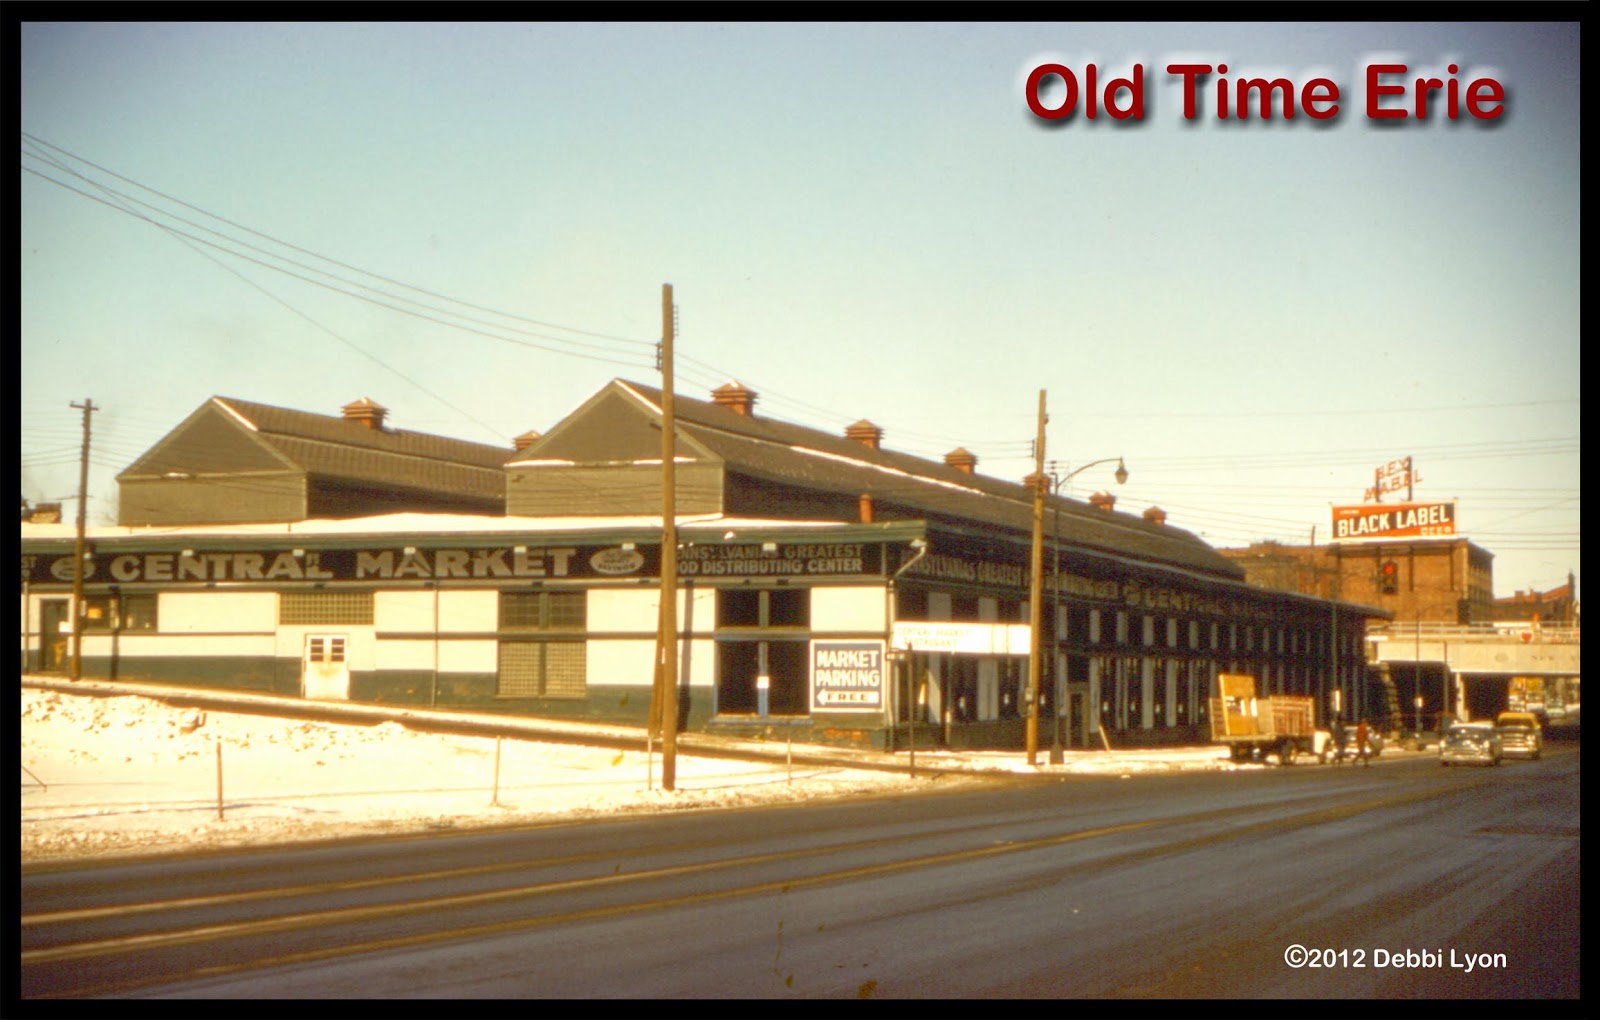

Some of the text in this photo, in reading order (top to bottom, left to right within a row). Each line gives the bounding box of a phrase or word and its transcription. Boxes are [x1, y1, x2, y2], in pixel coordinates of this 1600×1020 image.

[1364, 469, 1423, 502] MABEL
[1337, 505, 1449, 537] BLACK LABEL
[1420, 526, 1452, 536] BEER
[784, 543, 863, 559] GREATEST
[109, 552, 334, 582] CENTRAL
[356, 548, 576, 578] MARKET
[678, 558, 862, 574] OD DISTRIBUTING CENTER
[816, 649, 879, 668] MARKET
[815, 669, 880, 687] PARKING
[827, 692, 868, 701] FREE
